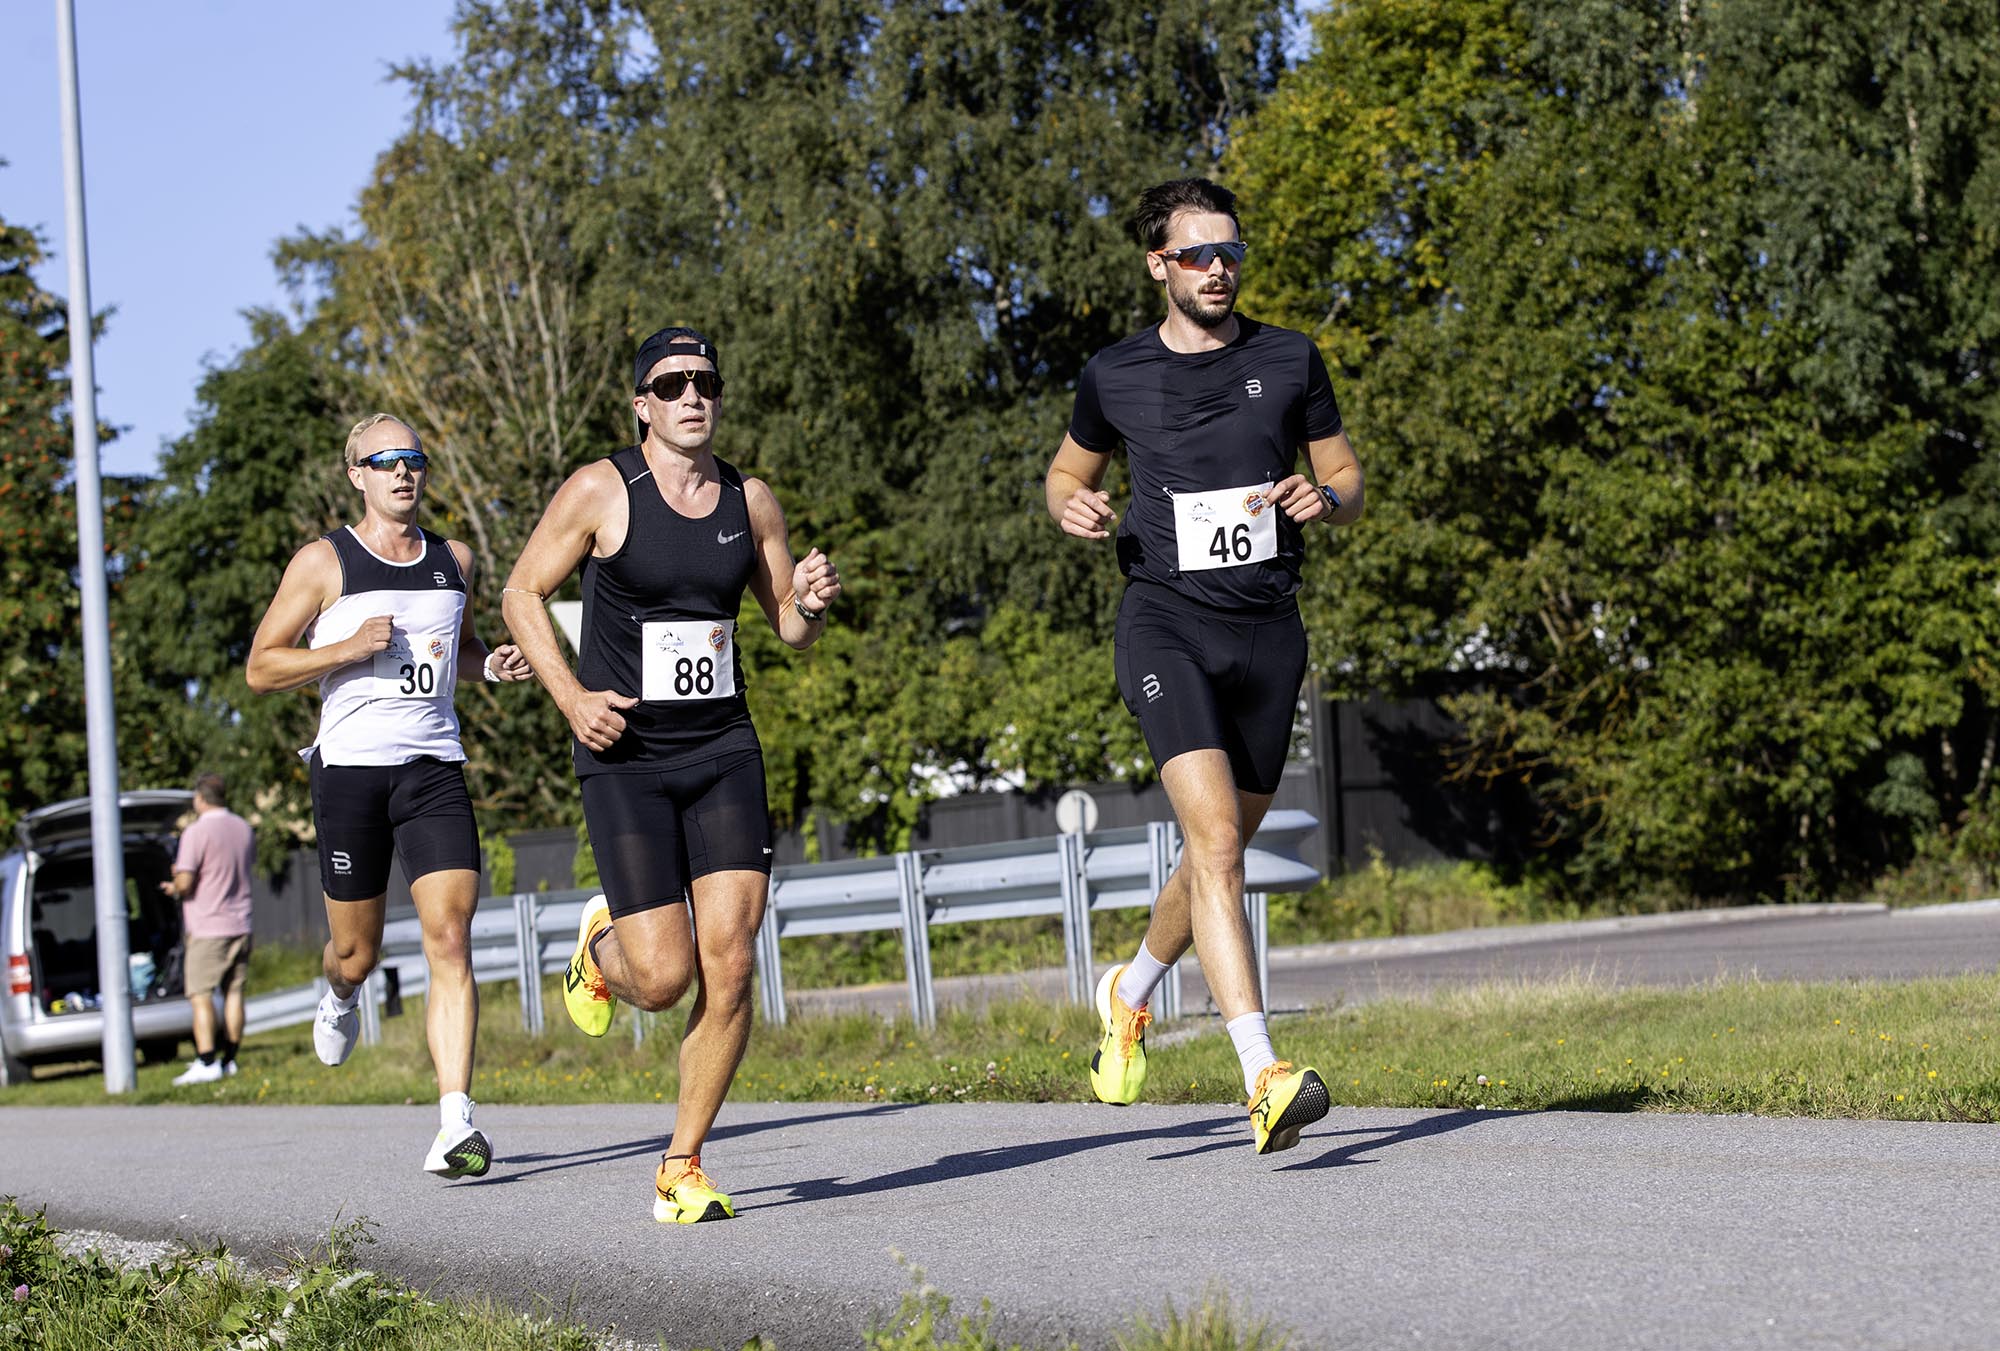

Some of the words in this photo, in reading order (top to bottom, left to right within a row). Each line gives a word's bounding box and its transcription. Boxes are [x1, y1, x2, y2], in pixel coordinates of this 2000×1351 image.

[1209, 523, 1252, 563] 46
[400, 663, 434, 695] 30
[674, 656, 714, 696] 88
